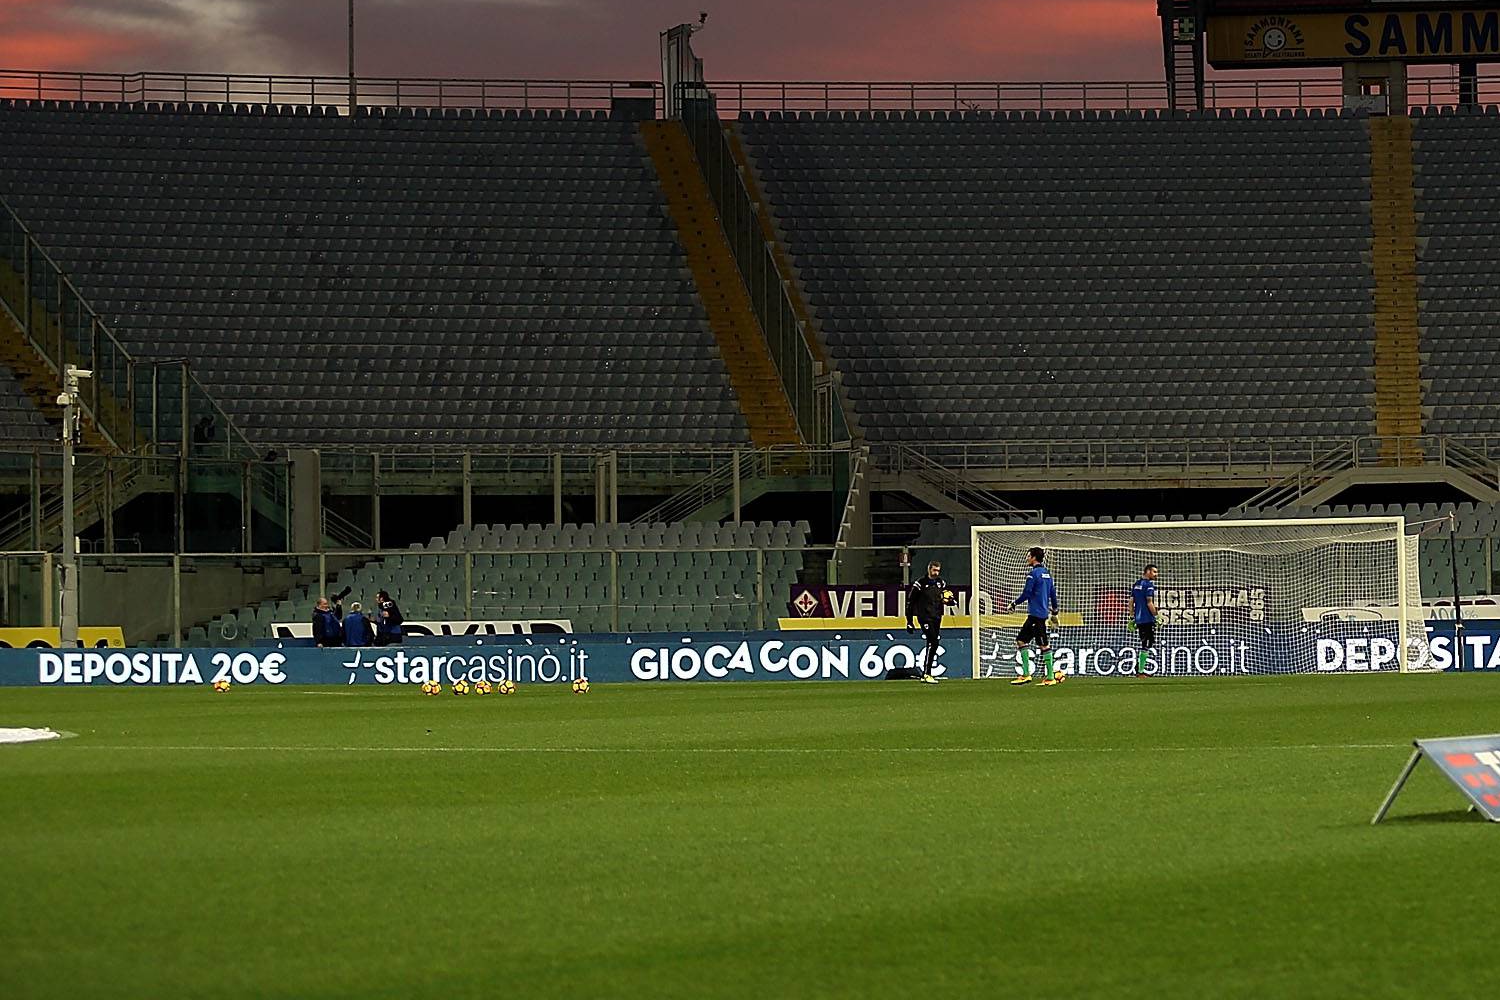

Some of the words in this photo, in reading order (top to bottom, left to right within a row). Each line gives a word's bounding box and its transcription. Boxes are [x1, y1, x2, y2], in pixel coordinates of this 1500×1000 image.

[1244, 16, 1305, 47] SAMMONTANA
[1193, 588, 1249, 608] VIOLA
[1158, 608, 1220, 625] SESTO
[39, 652, 203, 684] DEPOSITA
[210, 652, 287, 684] 20€
[374, 647, 589, 683] starcasinò.it
[630, 640, 754, 680] GIOCA
[759, 640, 849, 678] CON
